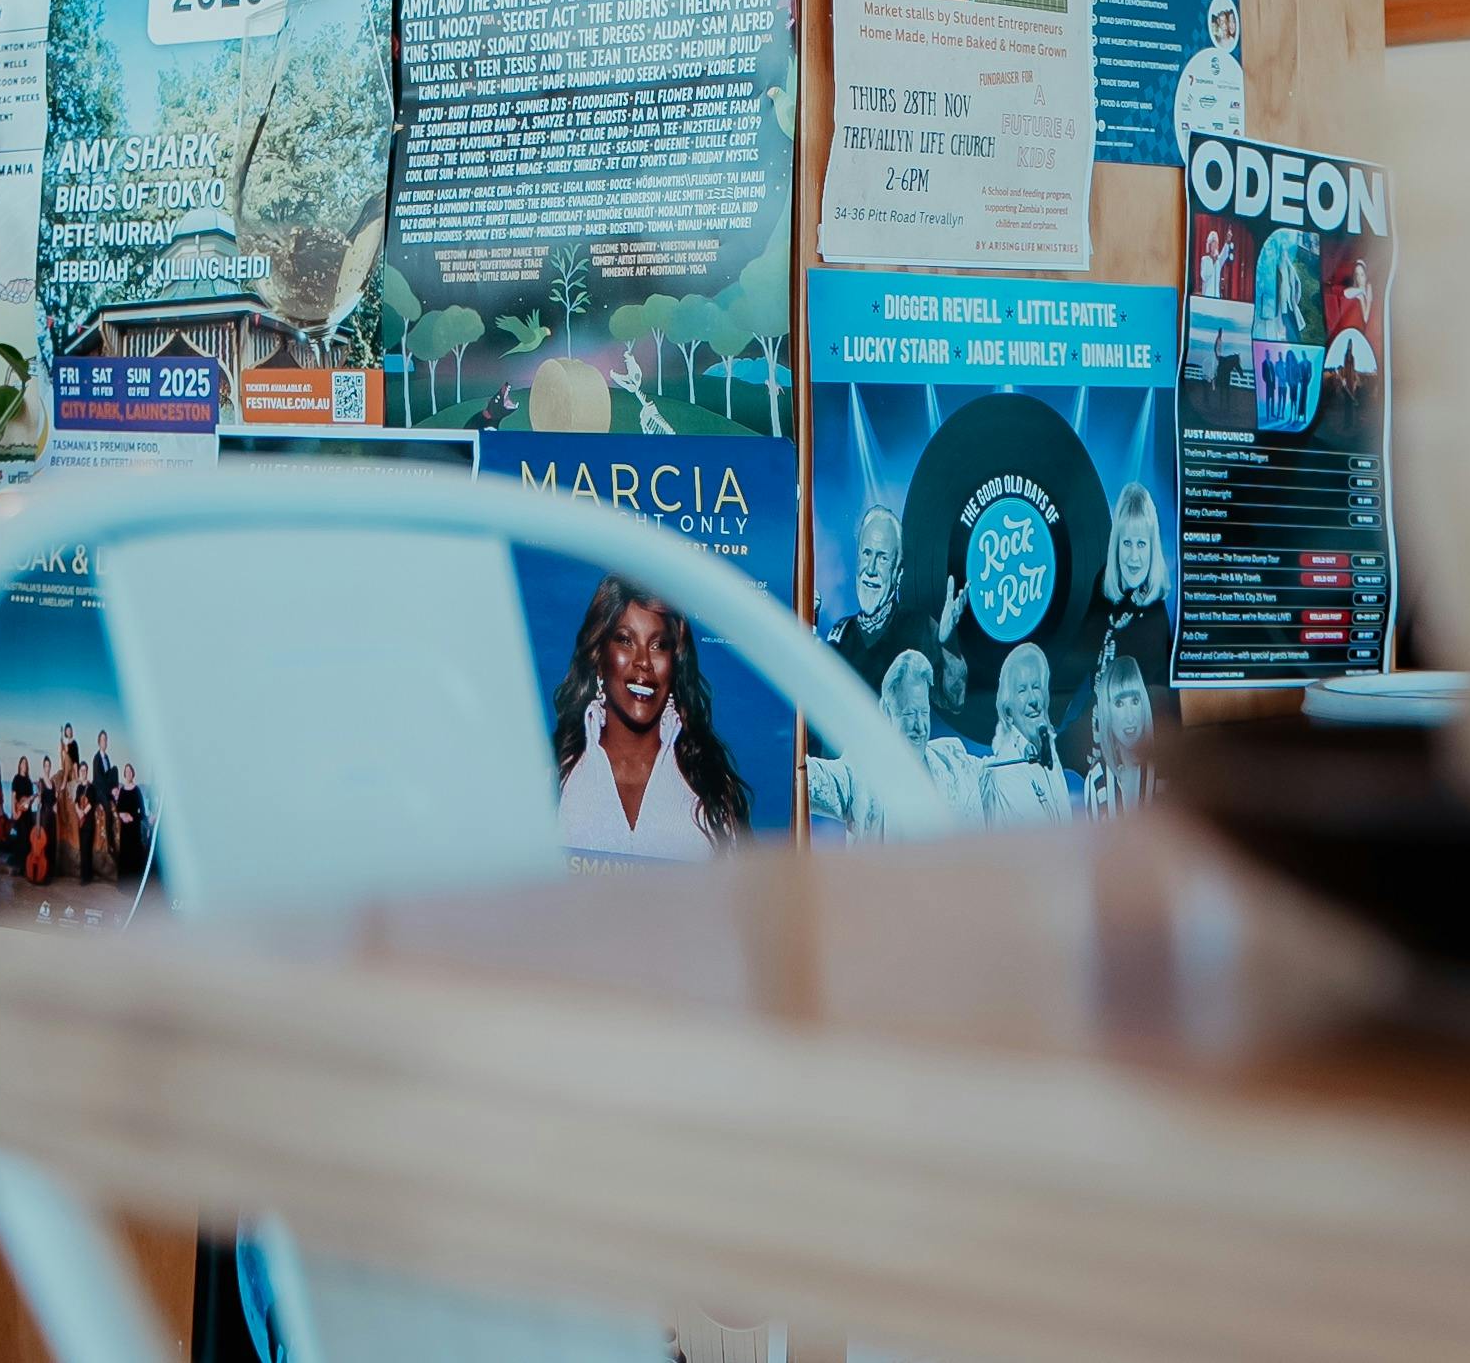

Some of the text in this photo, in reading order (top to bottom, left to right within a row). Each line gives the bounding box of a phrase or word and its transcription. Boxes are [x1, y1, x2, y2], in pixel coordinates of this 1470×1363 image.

[864, 1, 1064, 36] Market Student Entrepreneurs
[849, 85, 971, 118] THURS 28TH NOV
[57, 133, 219, 175] AMY SHARK
[843, 125, 996, 158] TREVALLYN LIFE CHURCH
[886, 167, 929, 192] 2-6PM
[1191, 140, 1388, 236] ODEON
[55, 178, 225, 213] BIRDS OF TOKYO
[834, 207, 964, 229] 34-36 Pitt Road Trevallyn
[52, 220, 177, 248] PETE MURRAY
[1037, 242, 1079, 253] MINISTRIES
[50, 256, 271, 283] JEBEDIAH KILLING HEIDI
[884, 294, 1117, 328] DIGGER REVELL LITTLE PATTIE
[843, 336, 1152, 369] LUCKY STARR JADE HURLEY DINAH LEE
[59, 367, 211, 397] FRI SAT SUN 2025
[61, 401, 211, 421] CITY LAUNCESTON
[246, 397, 330, 410] FESTIVALE.COM.AU
[53, 440, 135, 452] TASMANIA'S PREMIUM
[1184, 429, 1254, 443] JUST ANNOUNCED
[520, 460, 749, 515] MARCIA
[960, 475, 1059, 528] THE GOOD OLD DAYS OF
[681, 514, 748, 535] ONLY
[714, 543, 748, 555] TOUR
[979, 514, 1035, 581] Rock
[996, 562, 1047, 625] Roll
